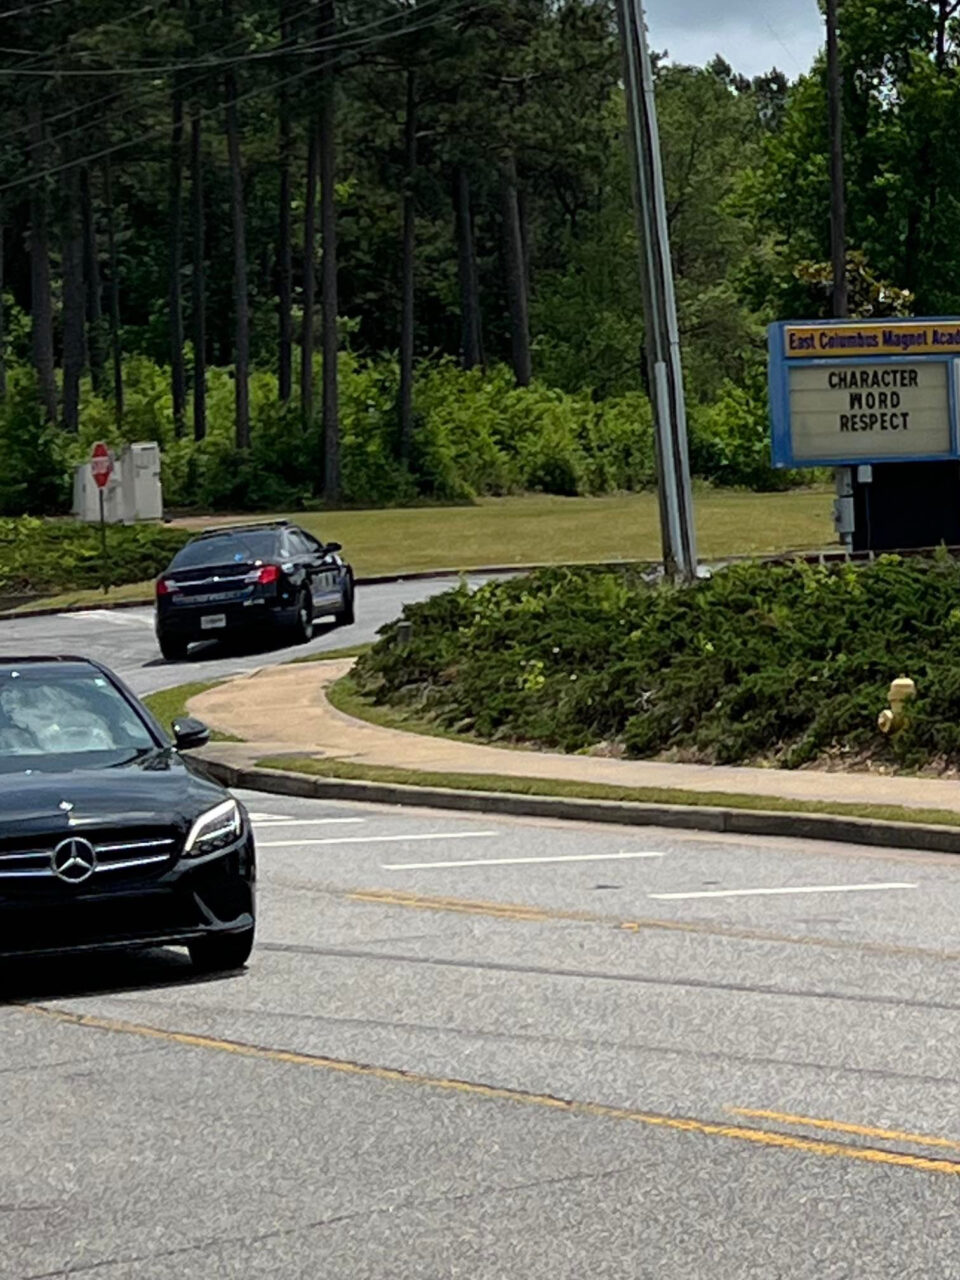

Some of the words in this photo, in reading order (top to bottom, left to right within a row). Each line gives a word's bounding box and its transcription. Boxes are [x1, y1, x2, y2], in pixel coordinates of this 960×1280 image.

[789, 332, 816, 350] East
[819, 331, 879, 349] Columbus
[882, 328, 928, 351] Magnet
[828, 369, 919, 389] CHARACTER
[849, 391, 901, 410] WORD
[840, 412, 909, 432] RESPECT
